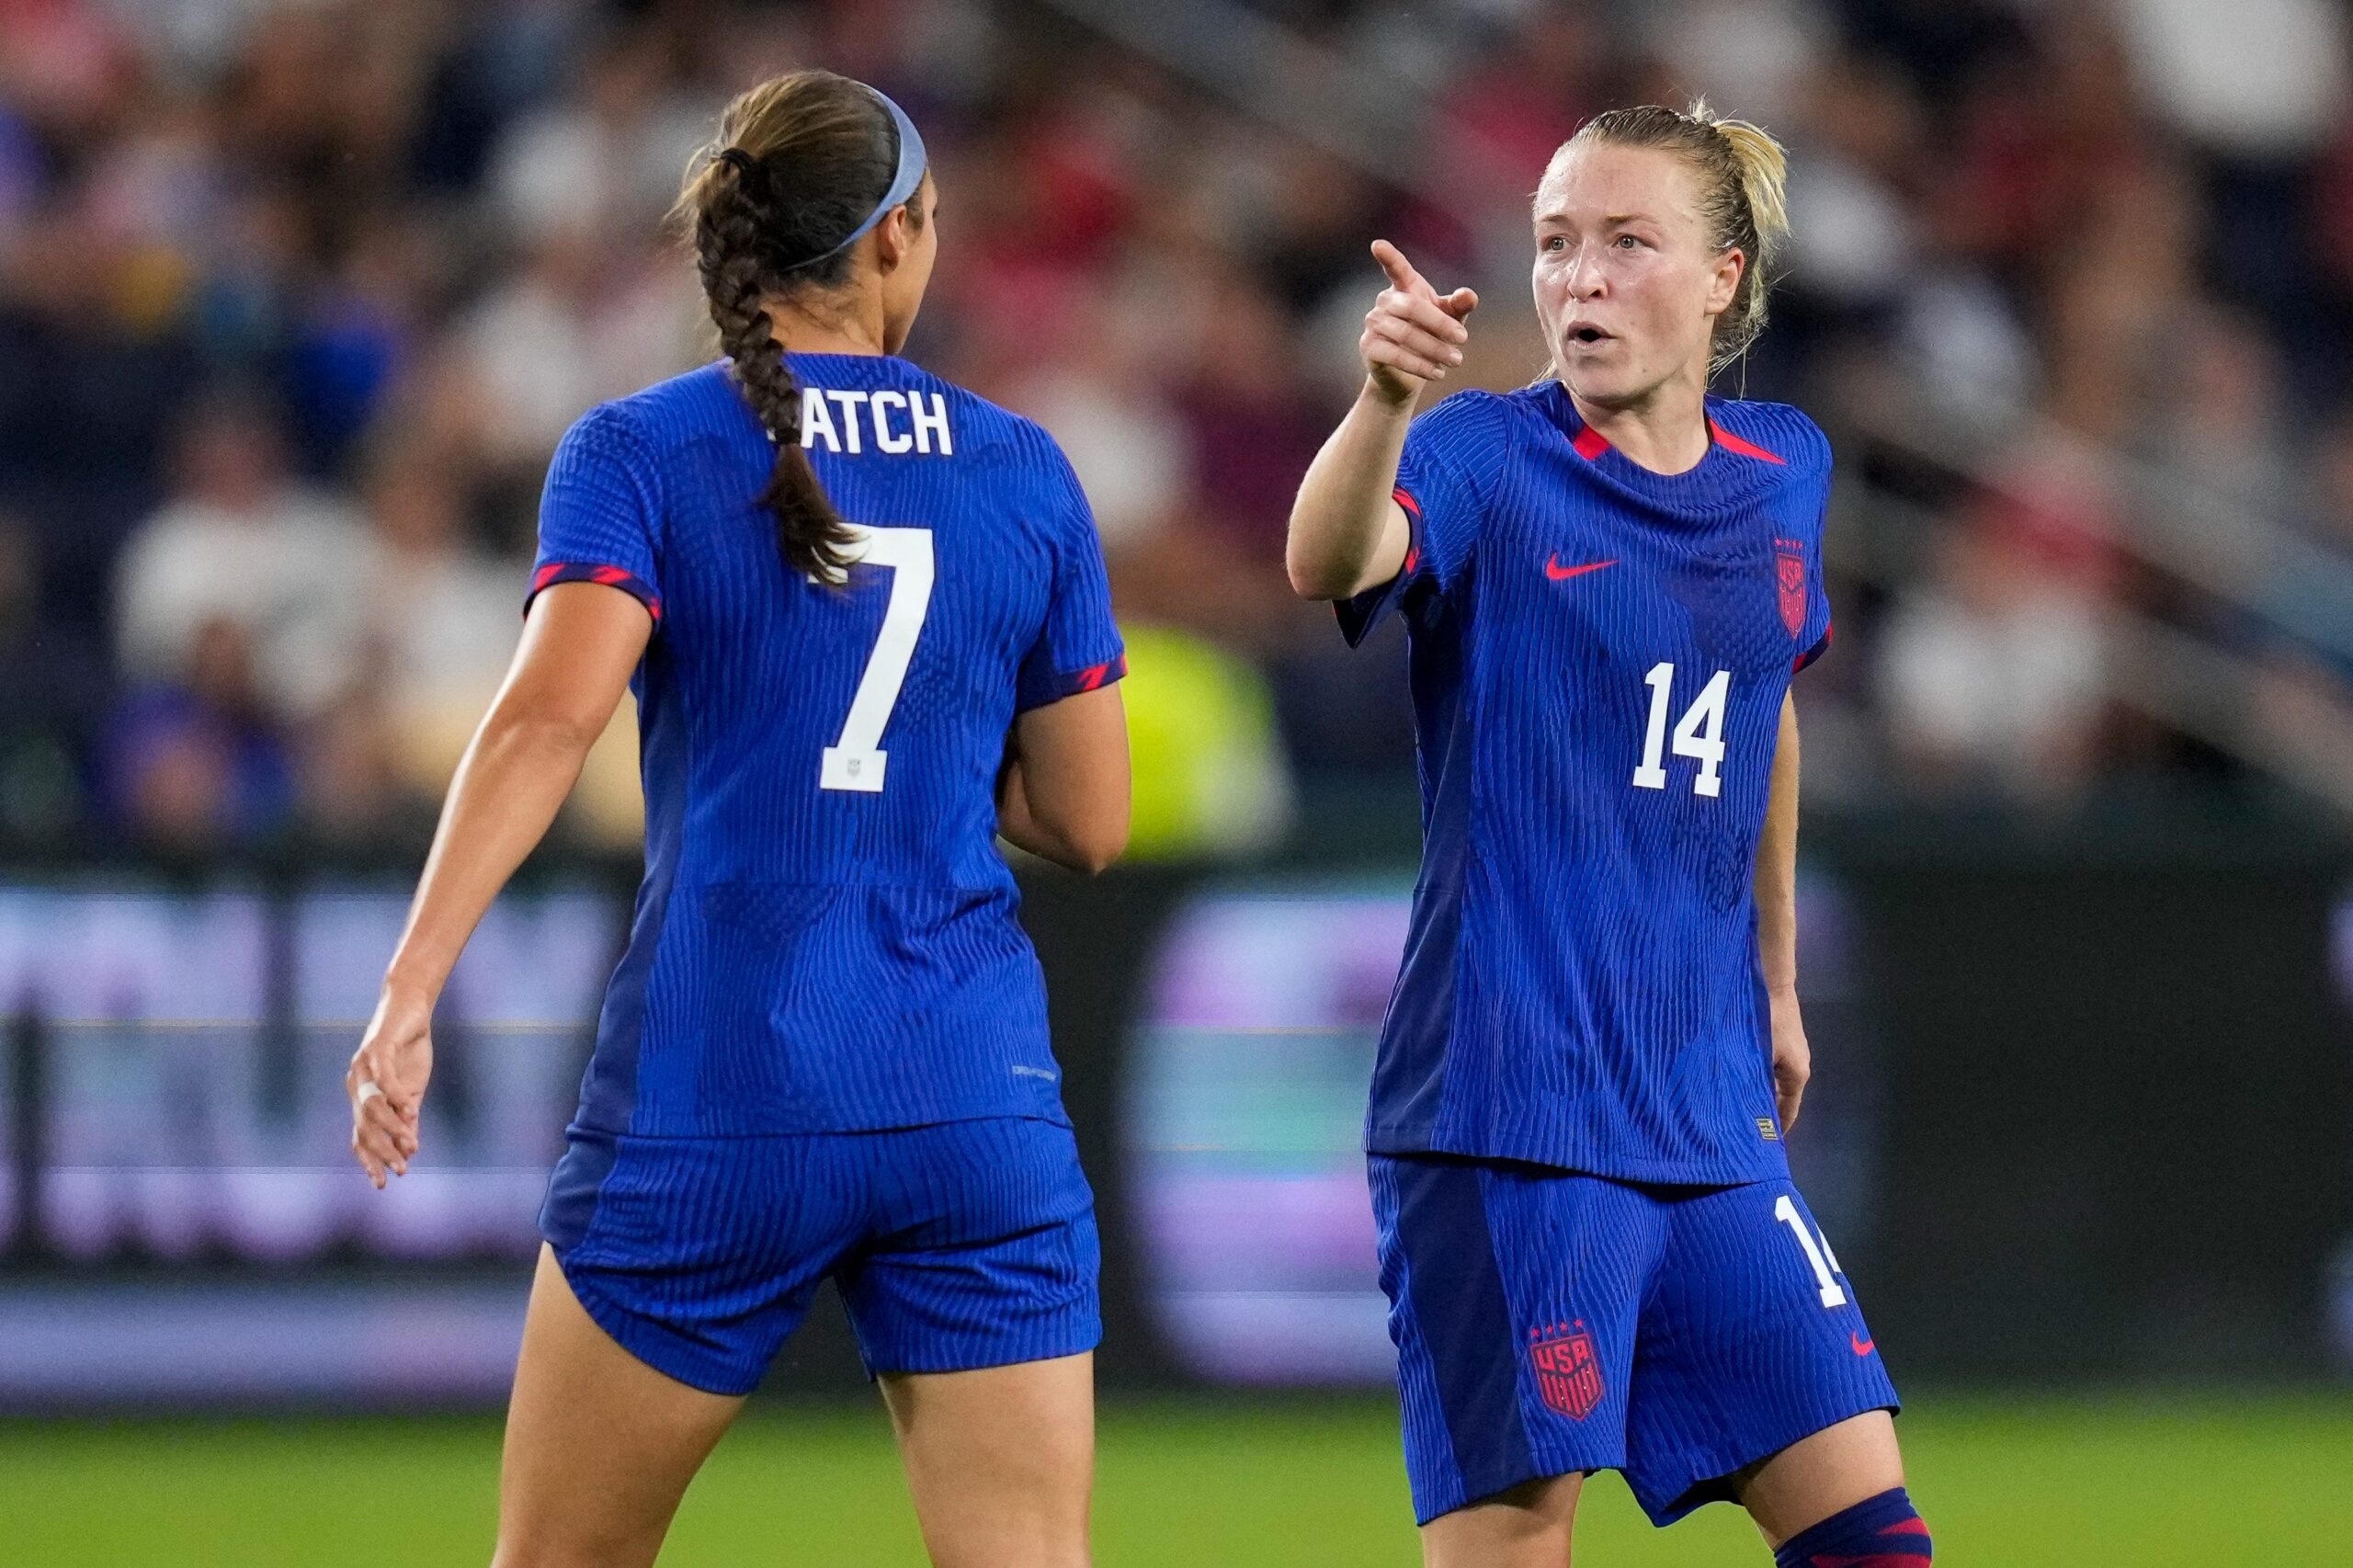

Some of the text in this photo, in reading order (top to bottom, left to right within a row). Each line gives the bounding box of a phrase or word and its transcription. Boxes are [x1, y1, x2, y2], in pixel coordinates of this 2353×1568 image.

[767, 387, 953, 456] ATCH
[807, 522, 935, 792] 7
[1632, 662, 1731, 798] 14
[1537, 1340, 1589, 1374] USA
